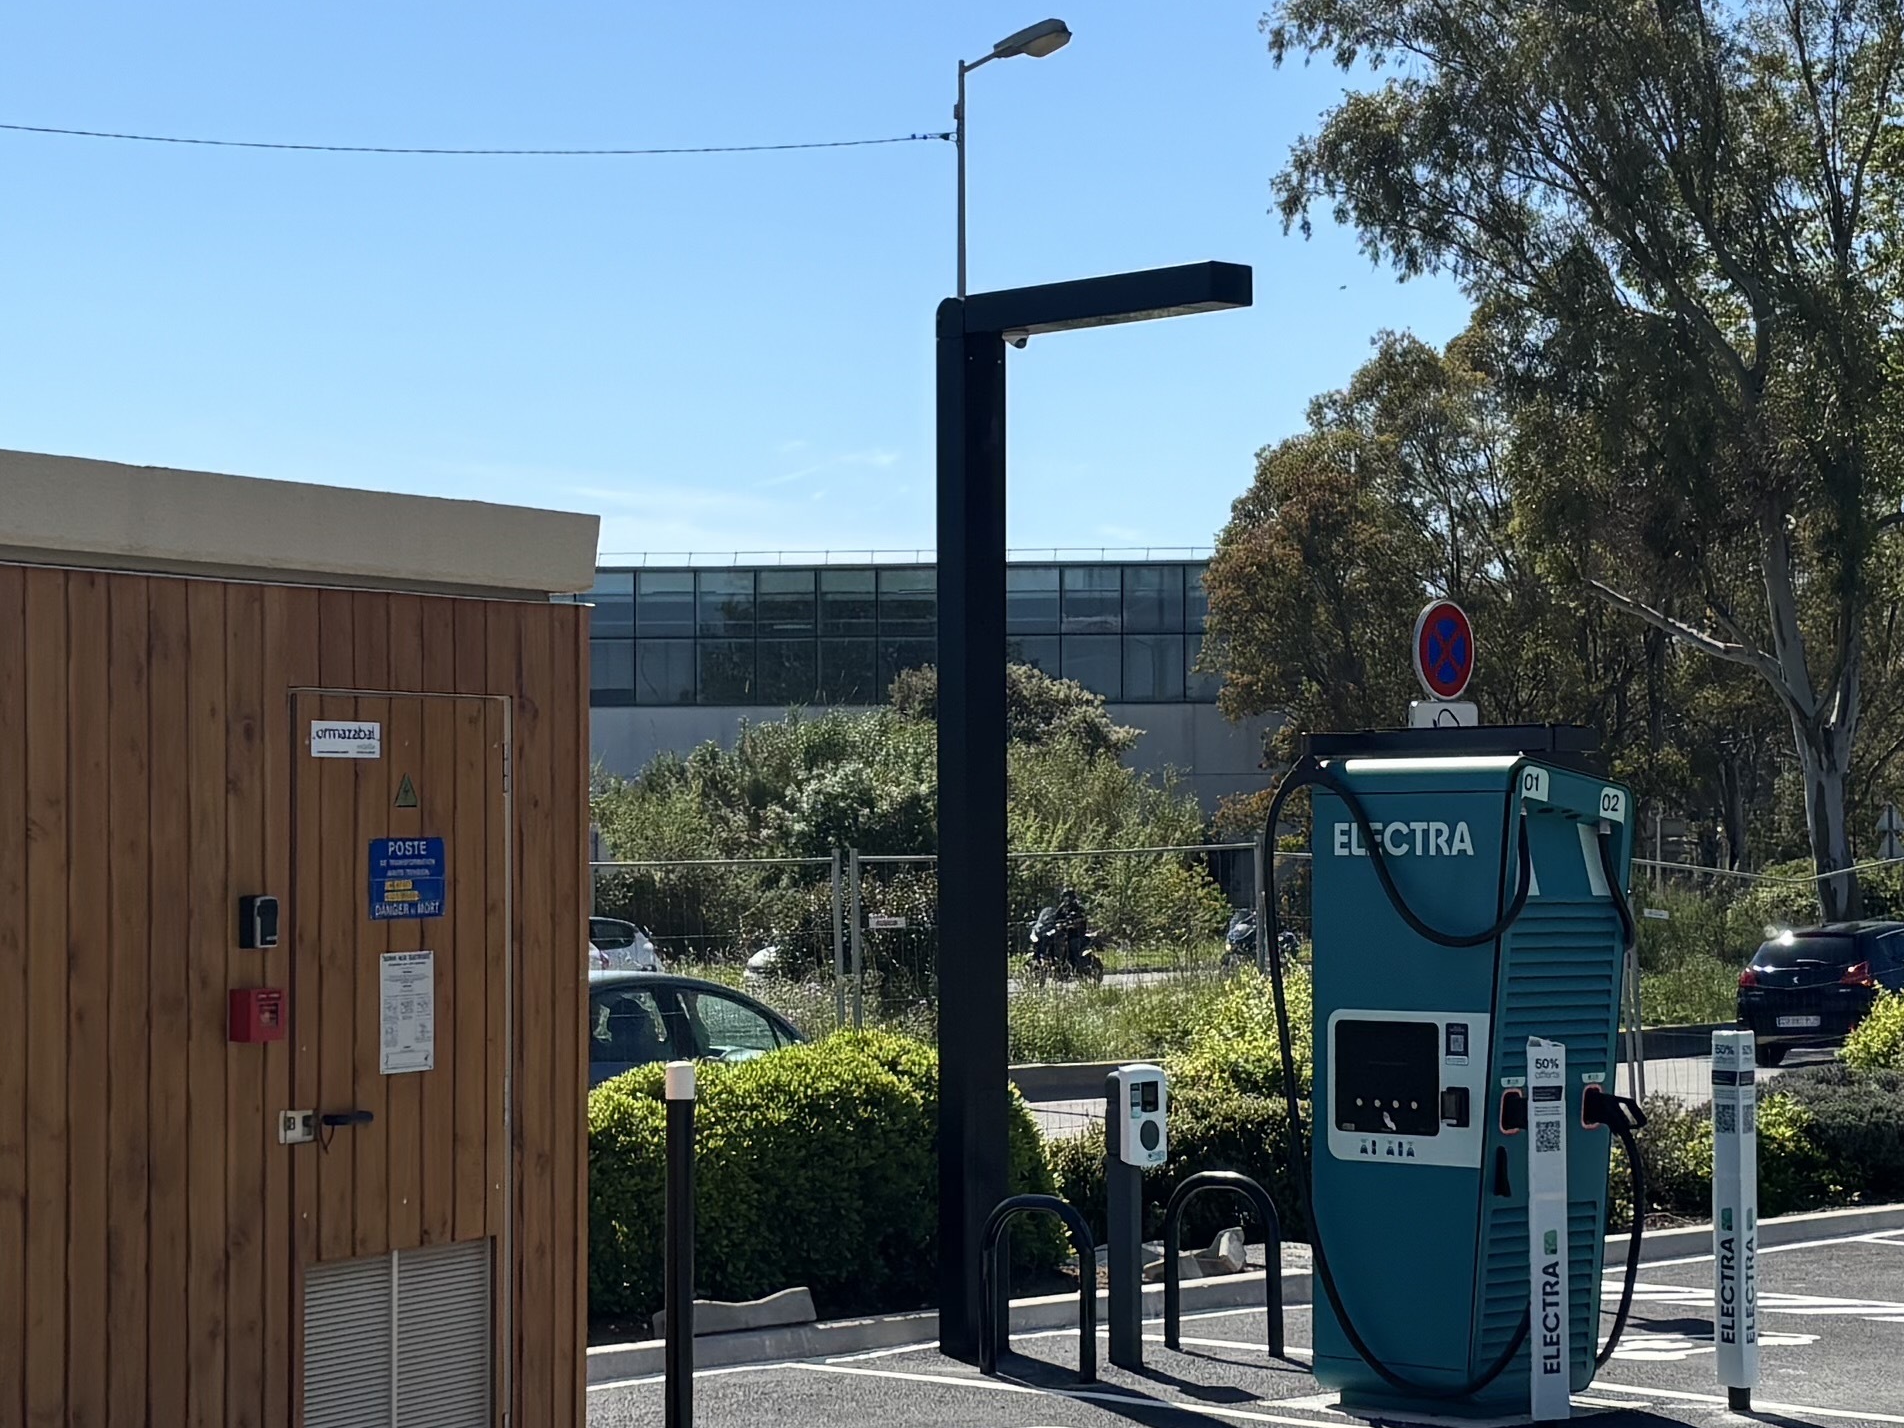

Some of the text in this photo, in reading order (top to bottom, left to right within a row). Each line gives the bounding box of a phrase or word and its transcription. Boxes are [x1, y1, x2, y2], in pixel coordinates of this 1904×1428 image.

[1524, 773, 1540, 792] 01
[1602, 793, 1620, 812] 02
[388, 841, 427, 856] POSTE
[1535, 1058, 1559, 1069] 50%
[1720, 1237, 1735, 1344] ELECTRA
[1745, 1236, 1755, 1344] ELECTRA
[1542, 1261, 1561, 1375] ELECTRA
